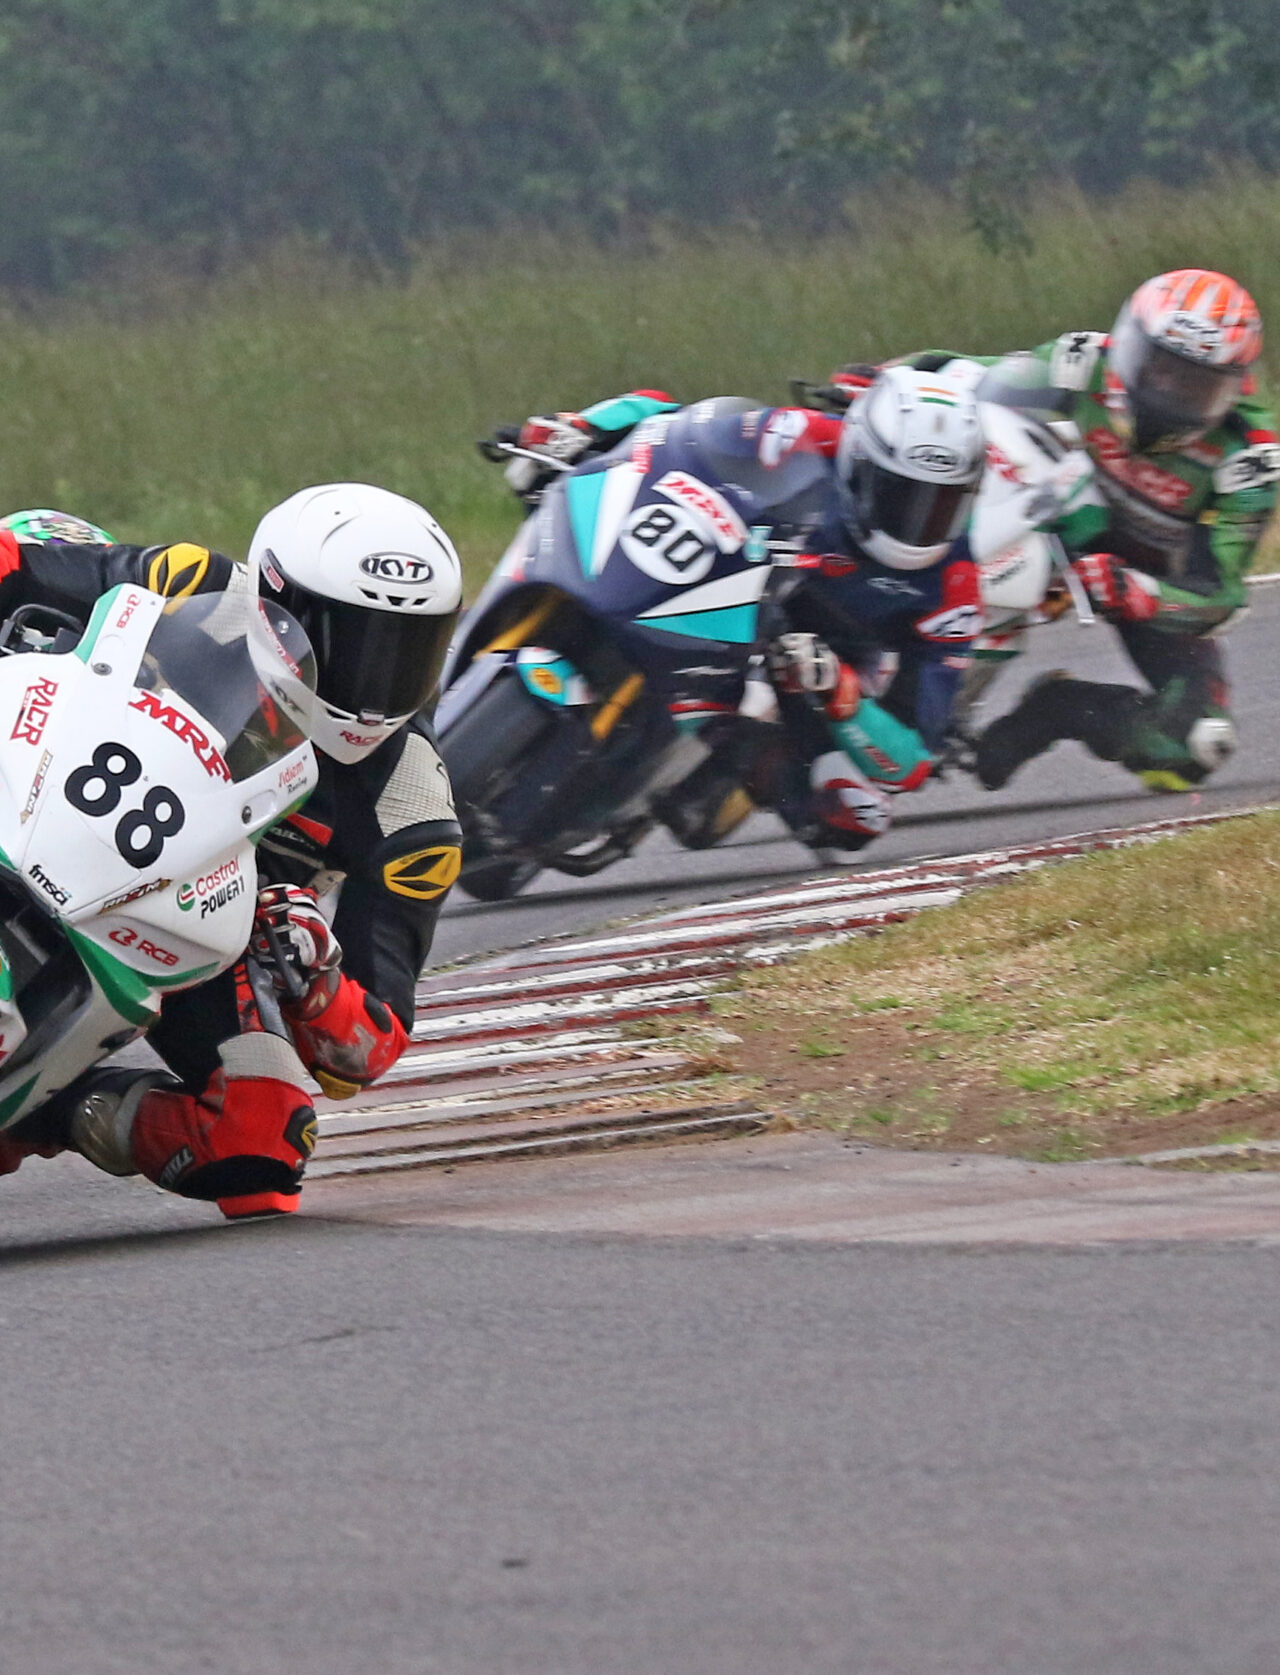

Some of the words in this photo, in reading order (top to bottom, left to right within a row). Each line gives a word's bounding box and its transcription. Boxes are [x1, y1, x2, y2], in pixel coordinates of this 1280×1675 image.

[632, 508, 705, 572] 80
[369, 557, 426, 579] KYT
[10, 676, 59, 746] RACR
[128, 690, 232, 783] MRF
[64, 741, 186, 869] 88
[29, 864, 70, 906] fmsci
[195, 855, 239, 896] Castrol
[136, 939, 180, 967] RCB
